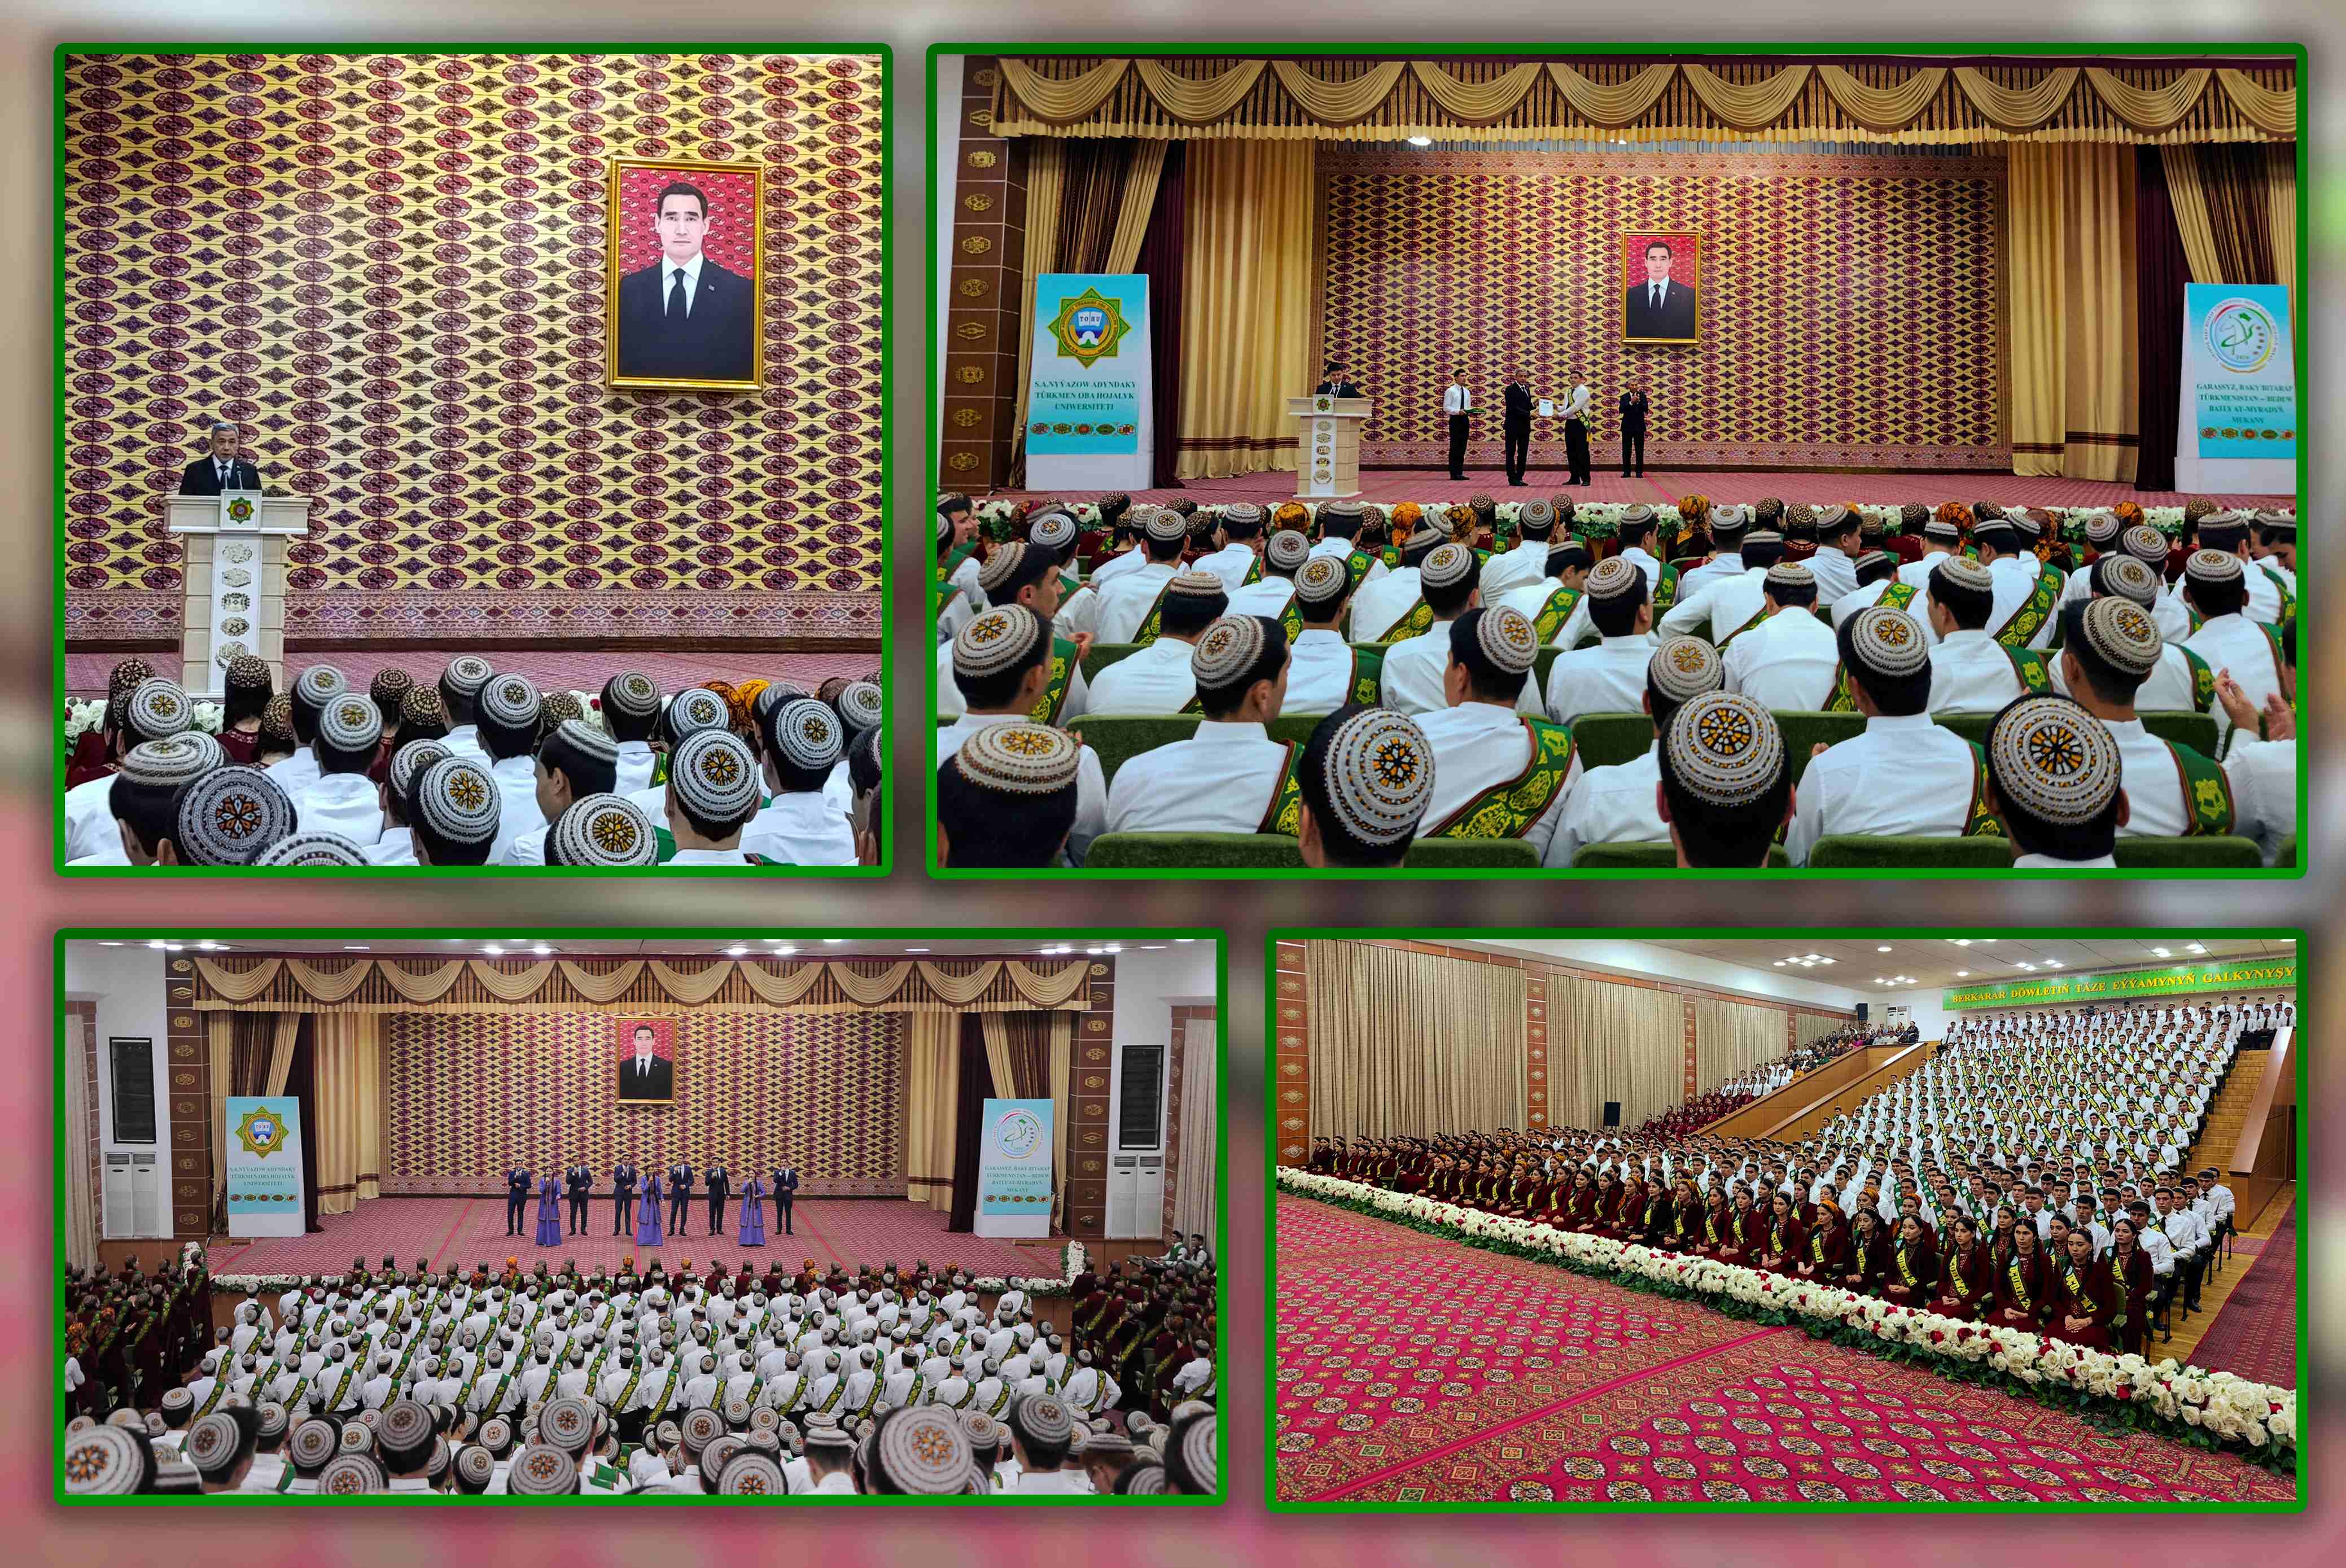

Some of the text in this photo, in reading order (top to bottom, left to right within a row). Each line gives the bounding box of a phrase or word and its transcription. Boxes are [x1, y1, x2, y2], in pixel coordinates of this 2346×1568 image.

[1035, 391, 1076, 399] TÜRKMEN
[1953, 966, 2295, 1002] BERKARAR DÖWLETIŇ TÄZE EÝÝAMYNYŇ GALKYNYŞY
